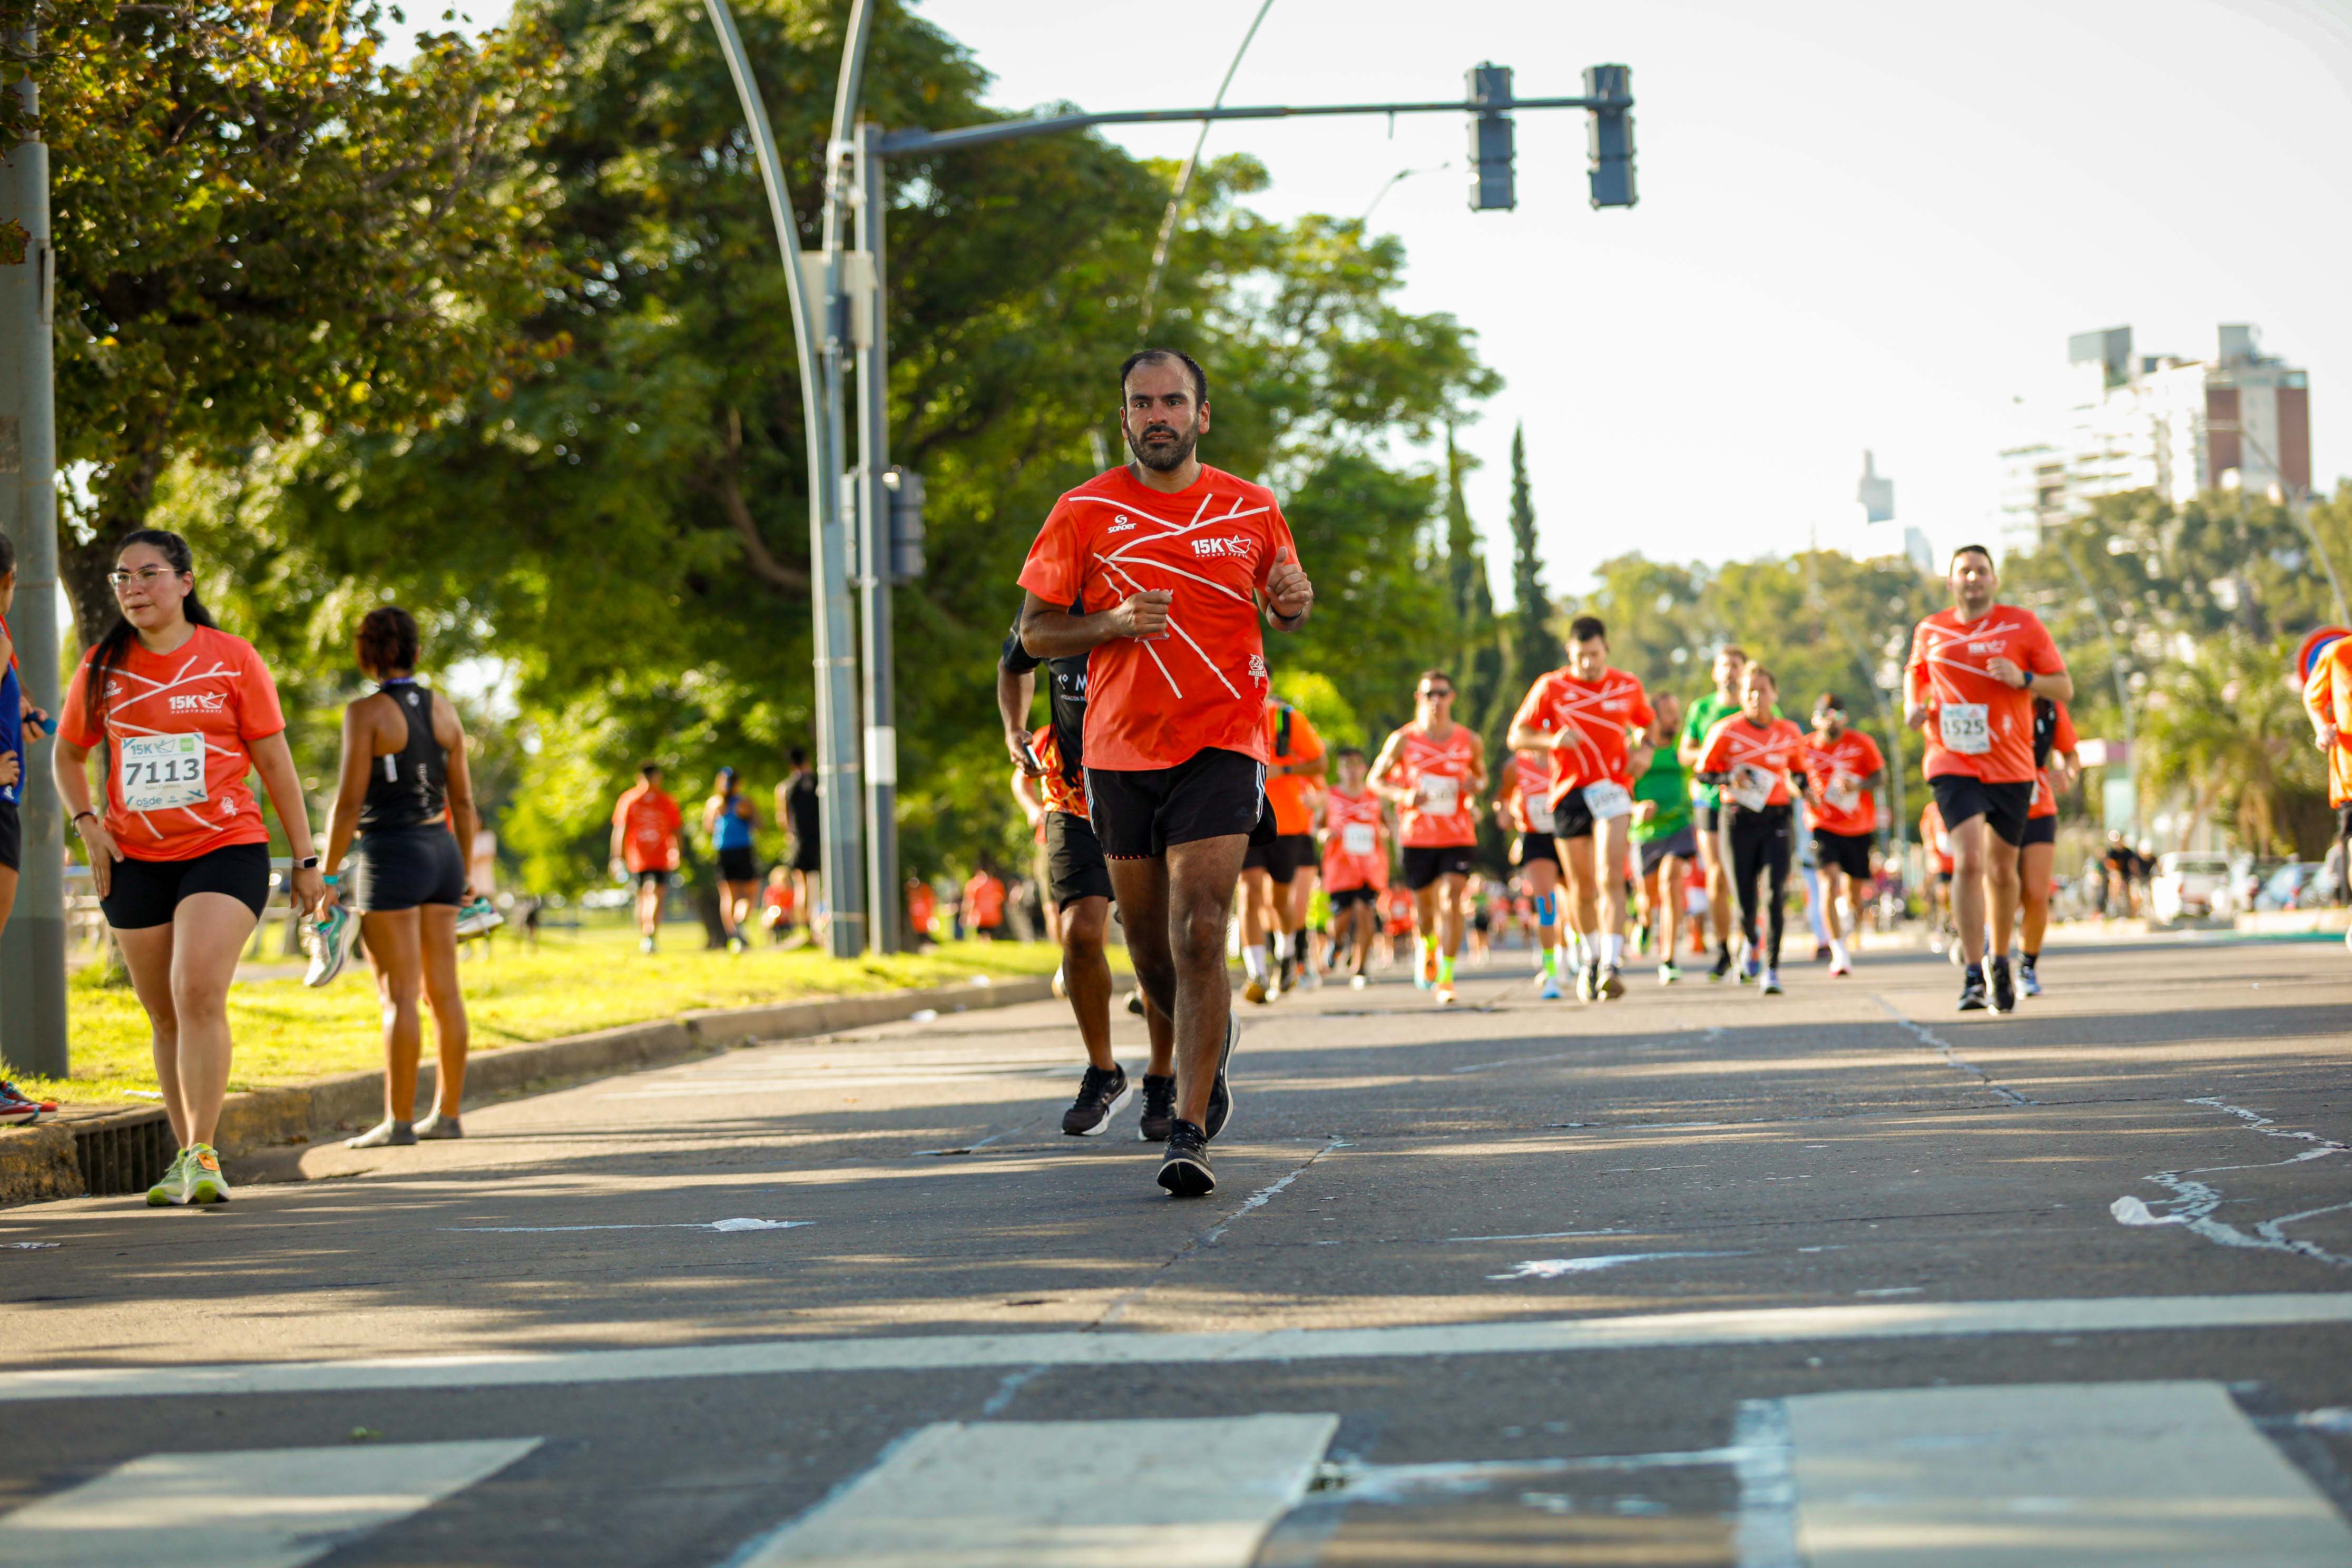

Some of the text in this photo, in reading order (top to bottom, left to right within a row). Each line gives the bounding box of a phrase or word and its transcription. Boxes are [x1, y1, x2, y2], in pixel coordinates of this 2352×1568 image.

[1191, 538, 1224, 554] 15K
[169, 695, 198, 710] 15K
[131, 743, 153, 754] 15K
[126, 758, 200, 786] 7113
